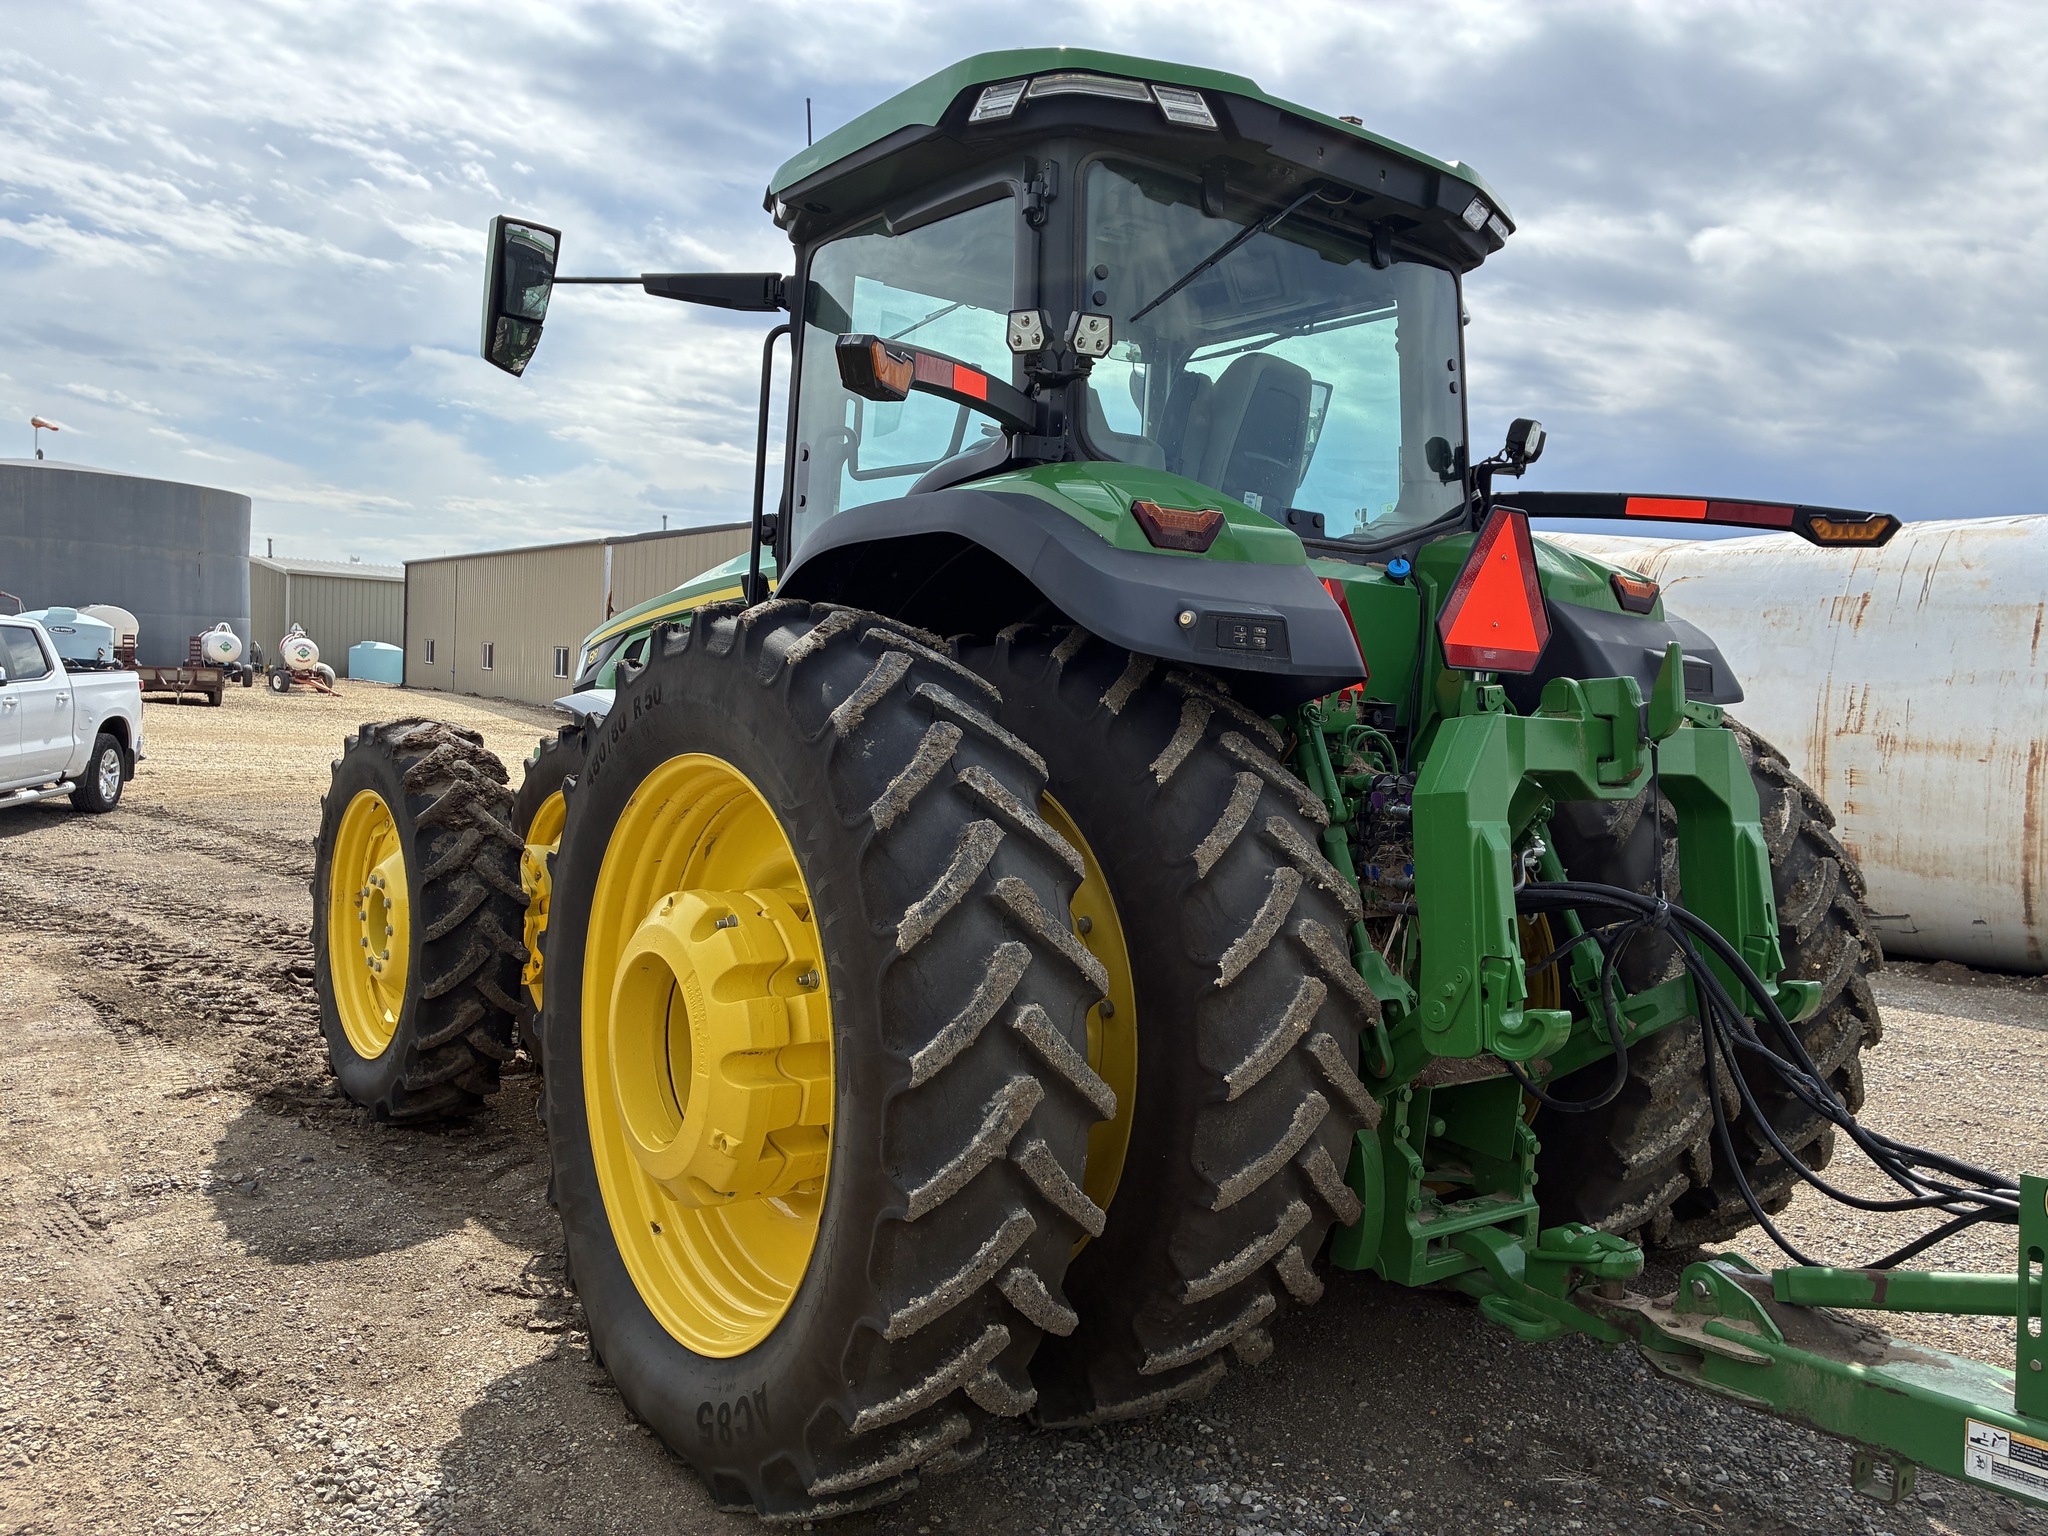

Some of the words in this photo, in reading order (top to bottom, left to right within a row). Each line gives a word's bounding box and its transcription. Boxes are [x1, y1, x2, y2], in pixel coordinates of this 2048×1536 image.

[588, 647, 599, 665] 8R
[586, 711, 628, 789] 480/80
[695, 1381, 771, 1449] AC85
